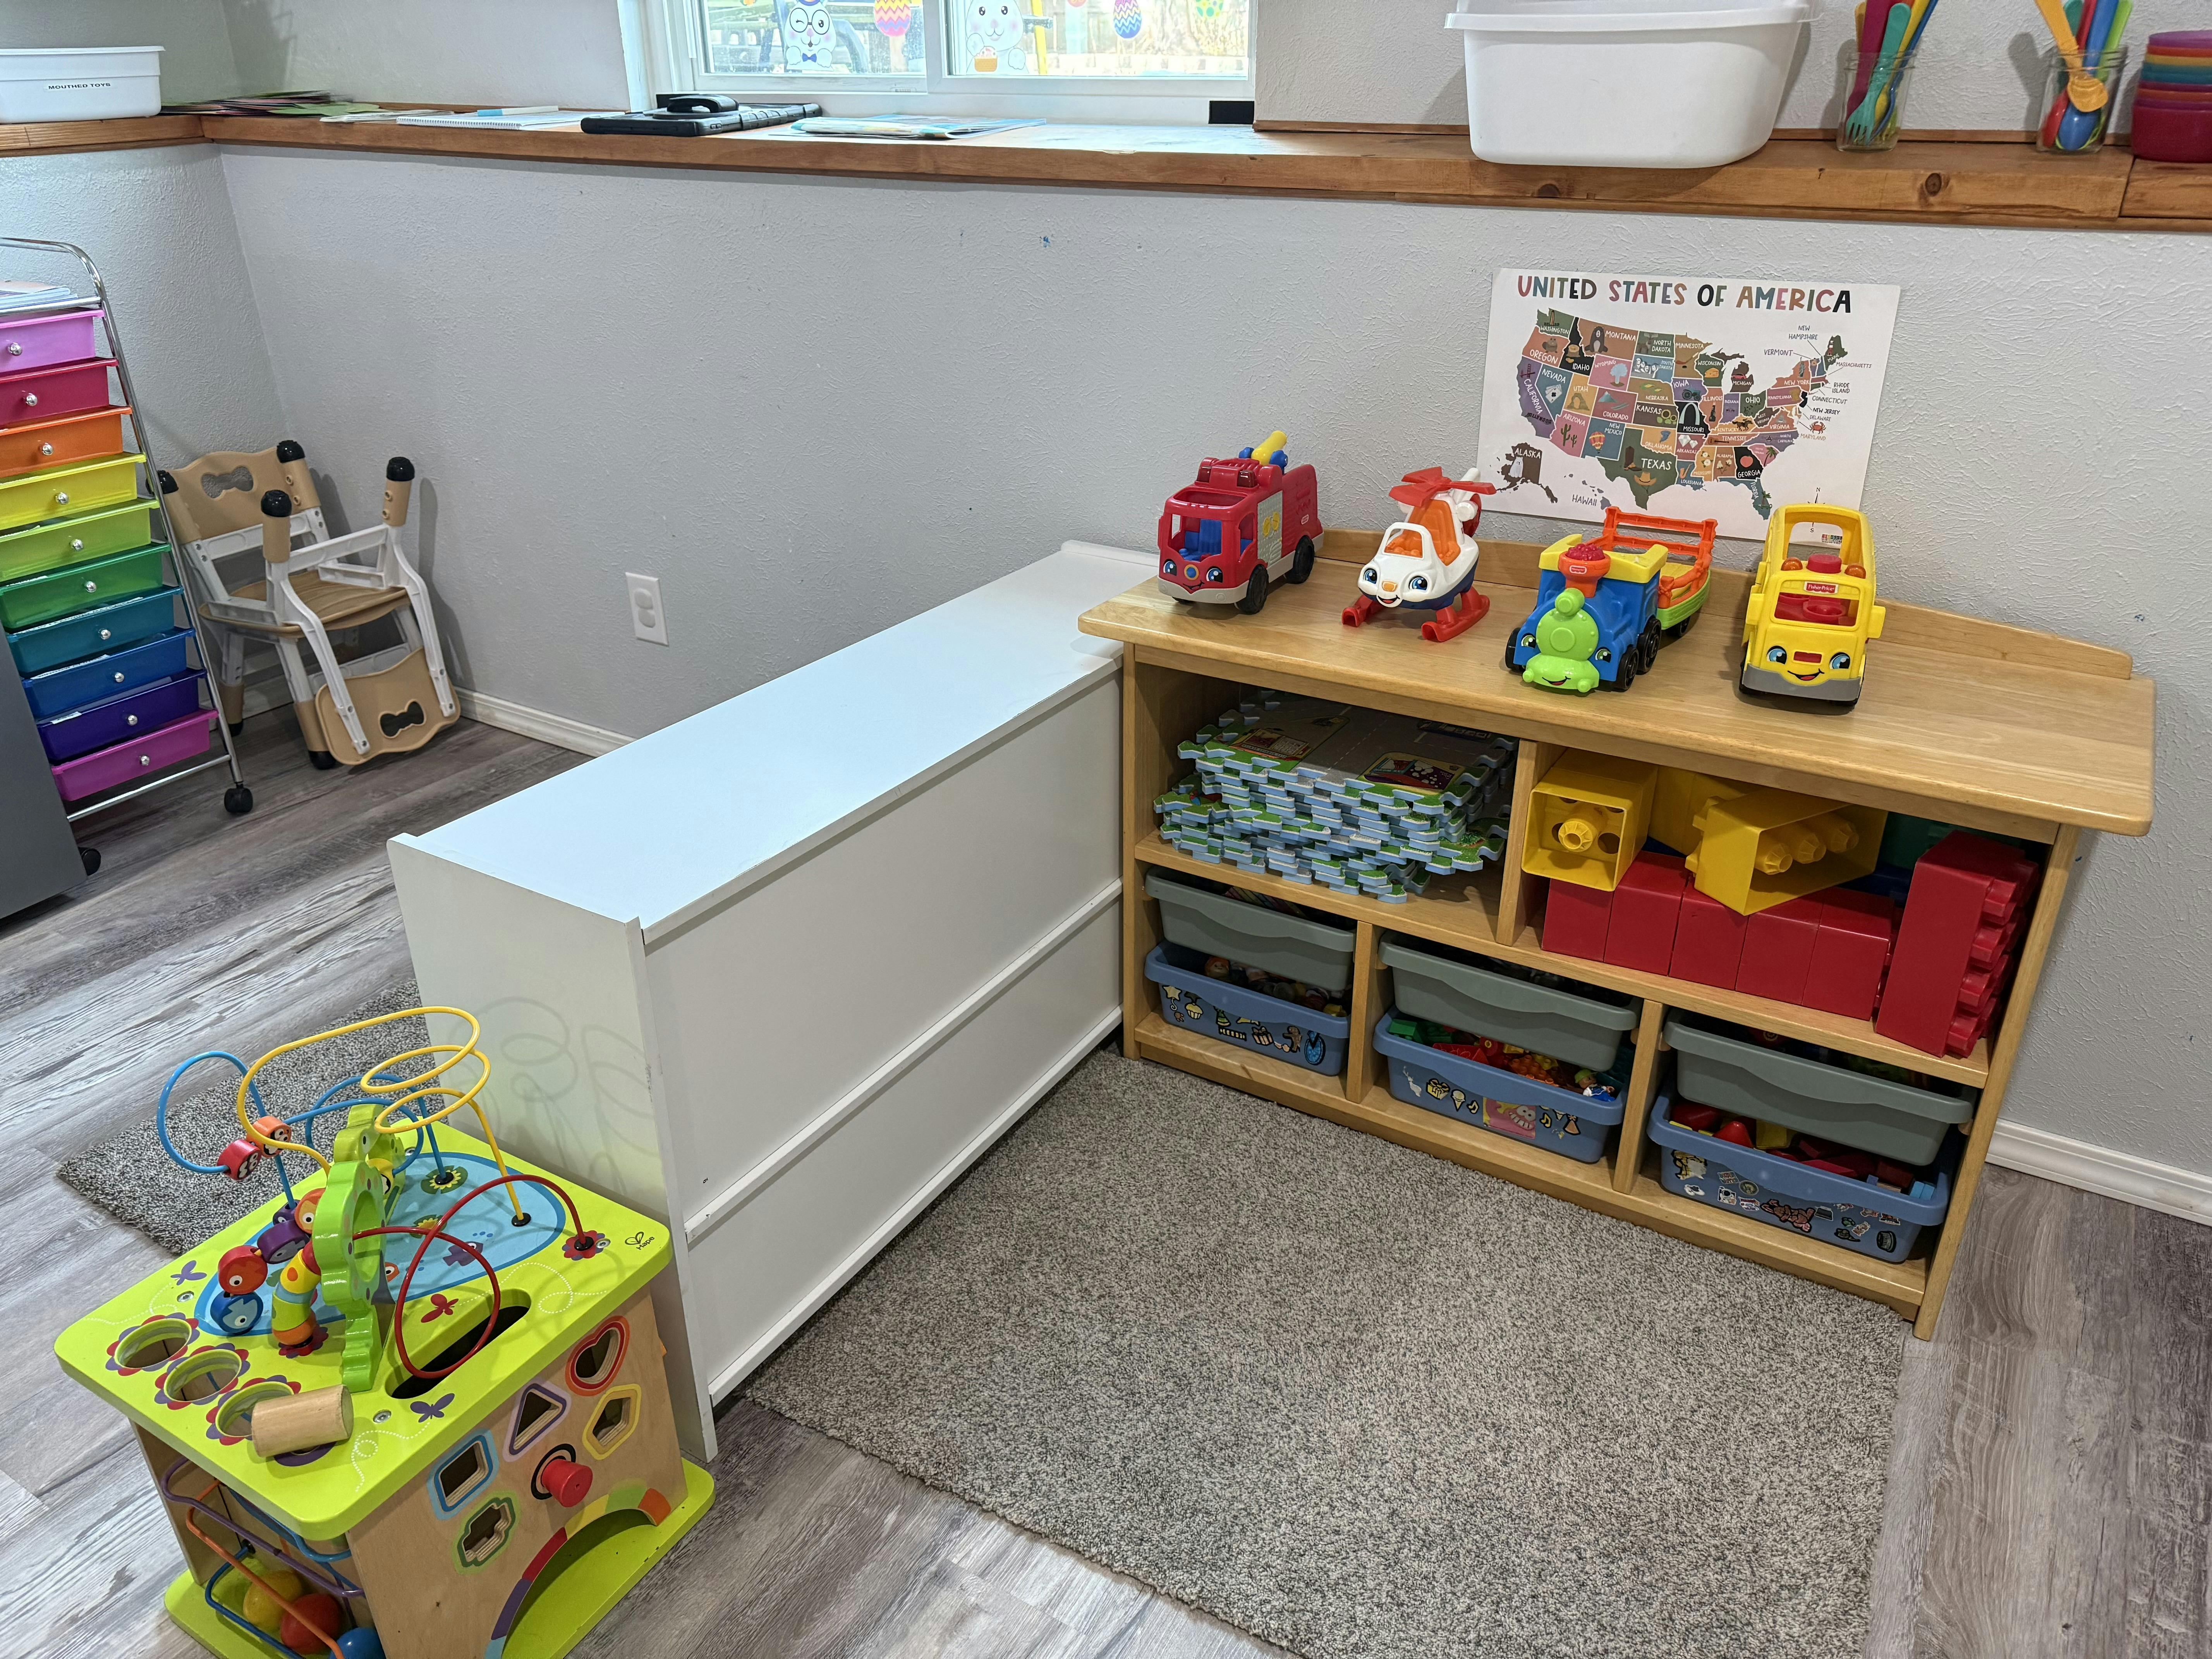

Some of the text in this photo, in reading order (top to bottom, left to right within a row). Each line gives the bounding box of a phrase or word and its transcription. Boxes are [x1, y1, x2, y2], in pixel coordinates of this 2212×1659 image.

[1518, 275, 1851, 313] UNITED STATES OF AMERICA
[1540, 326, 1569, 334] WASHINGTON
[1605, 330, 1637, 341] MONTANA
[1530, 349, 1559, 364] OREGON
[1827, 353, 1839, 362] MAINE
[1594, 359, 1616, 368] WYOMING
[1542, 368, 1566, 383] NEVADA
[1524, 379, 1543, 414] CALIFORNIA
[1812, 396, 1848, 404] CONNECTICUT
[1636, 404, 1662, 415] KANSAS
[1563, 413, 1585, 426] ARIZONA
[1603, 411, 1628, 420] COLORADO
[1645, 441, 1672, 451] OKLAHOMA
[1515, 448, 1541, 459] ALASKA
[1641, 458, 1672, 470] TEXAS
[1750, 482, 1759, 499] FLORIDA
[1572, 494, 1597, 506] HAWAII
[636, 1237, 655, 1250] Hape
